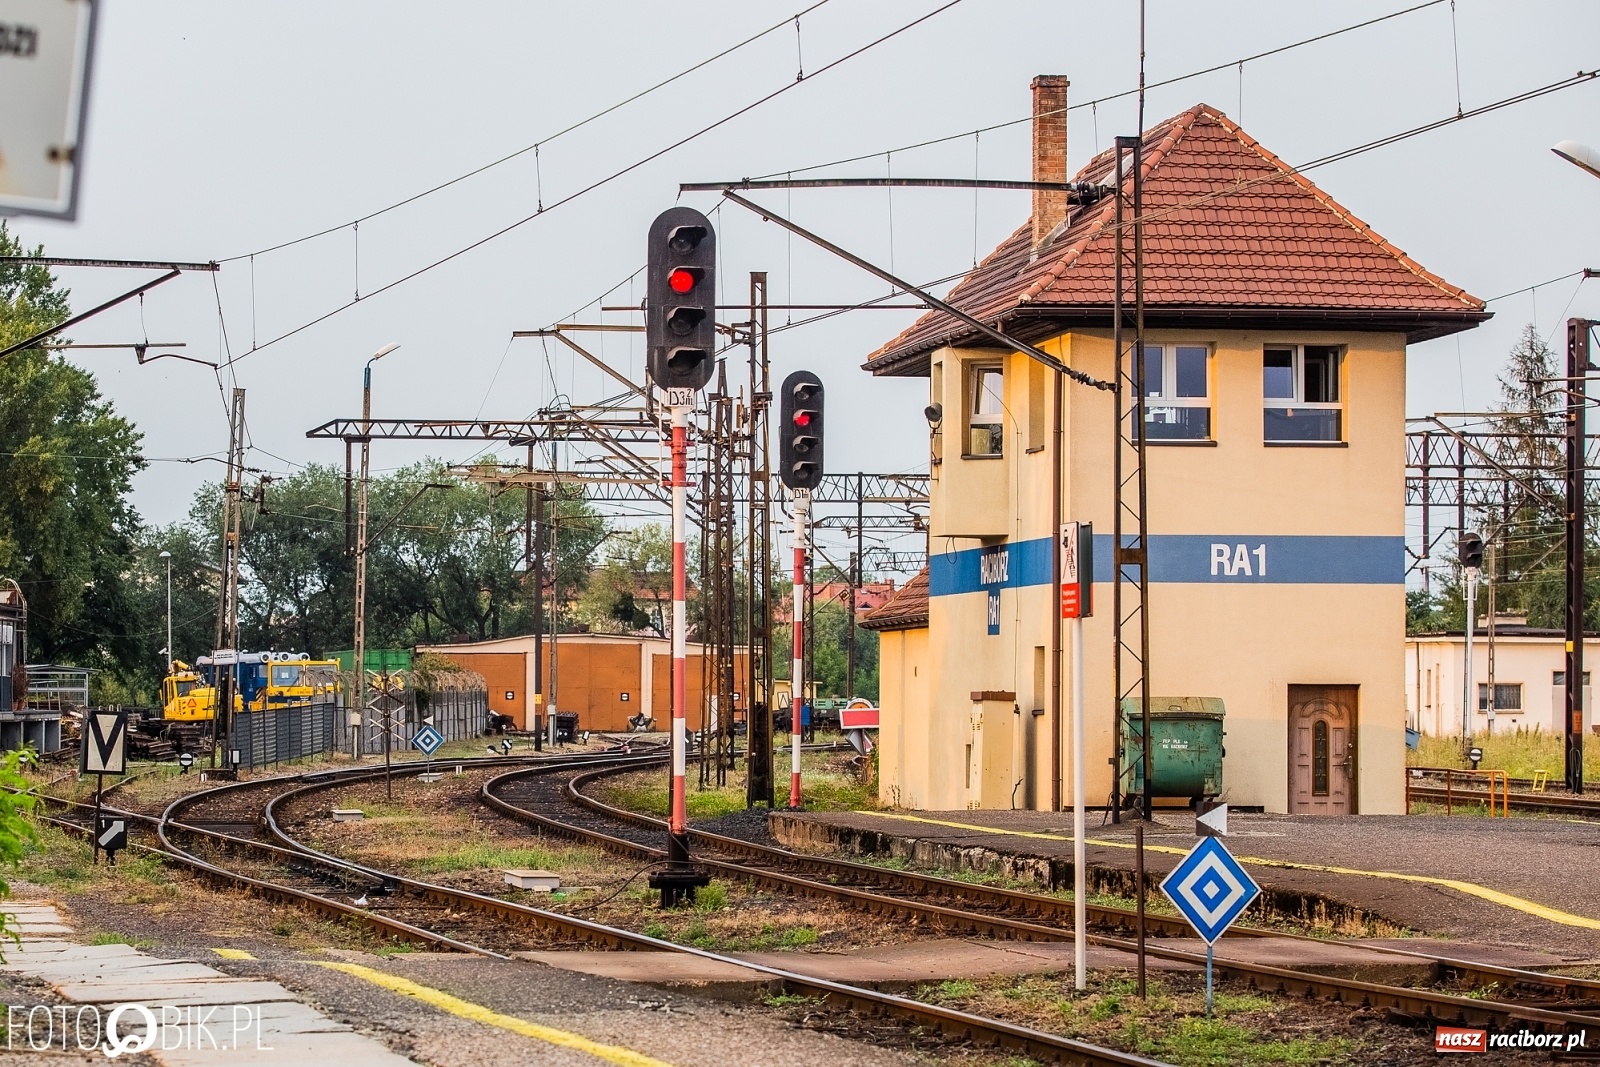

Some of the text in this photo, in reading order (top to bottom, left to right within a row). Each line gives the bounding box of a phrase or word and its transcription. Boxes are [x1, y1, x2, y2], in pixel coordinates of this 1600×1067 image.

[981, 546, 1009, 585] RACIBÓRZ
[1210, 543, 1266, 577] RA1
[988, 595, 1000, 626] RA1
[101, 819, 105, 829] 1
